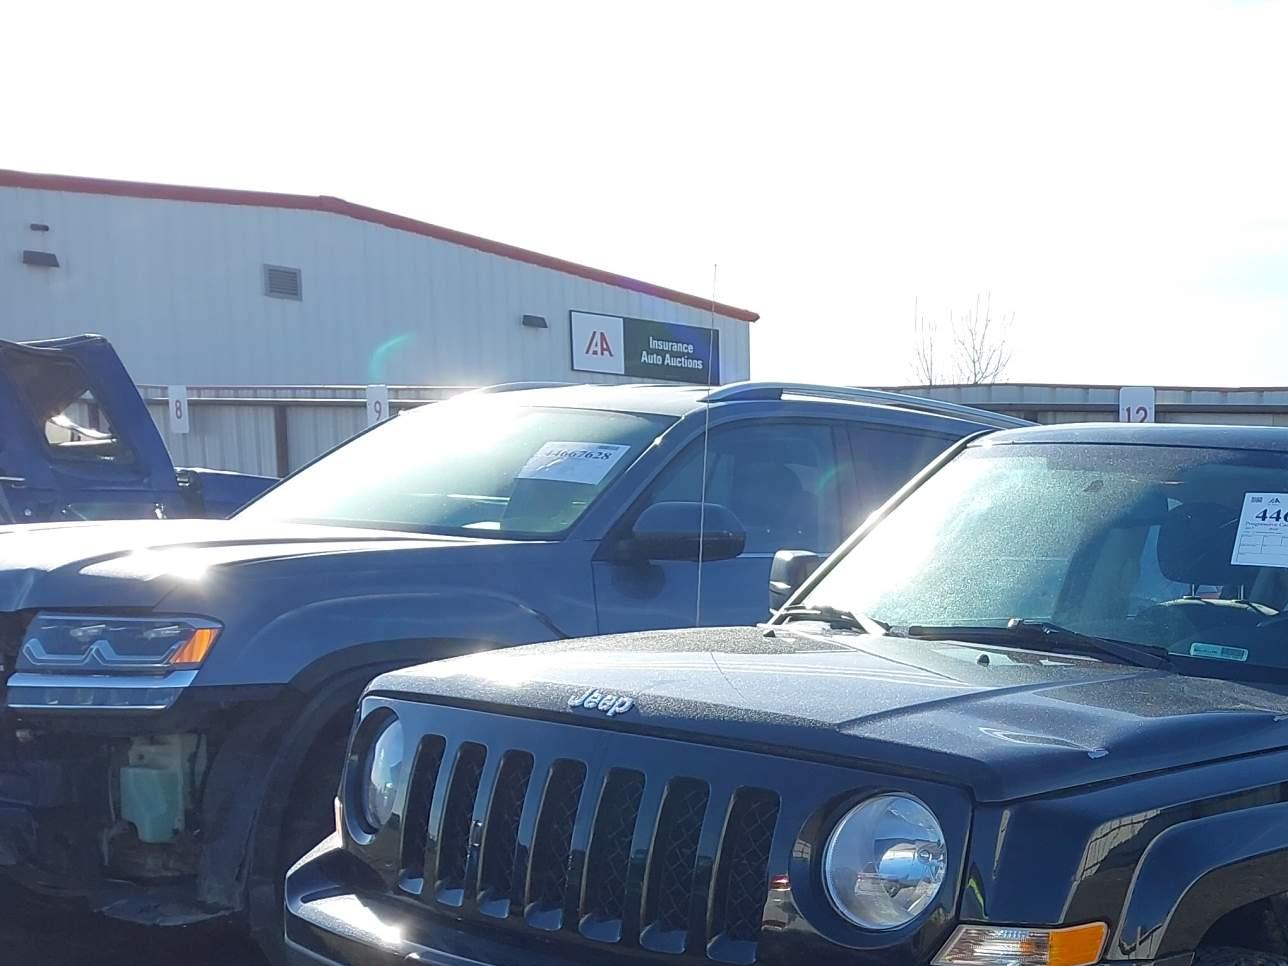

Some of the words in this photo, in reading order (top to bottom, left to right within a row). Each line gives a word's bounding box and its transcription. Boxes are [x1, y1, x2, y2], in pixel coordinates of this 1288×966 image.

[649, 336, 694, 353] Insurance
[641, 350, 663, 365] Auto
[664, 353, 703, 369] Auctions
[175, 399, 182, 419] 8
[374, 400, 382, 421] 9
[1125, 406, 1148, 424] 12
[568, 687, 634, 716] Jeep
